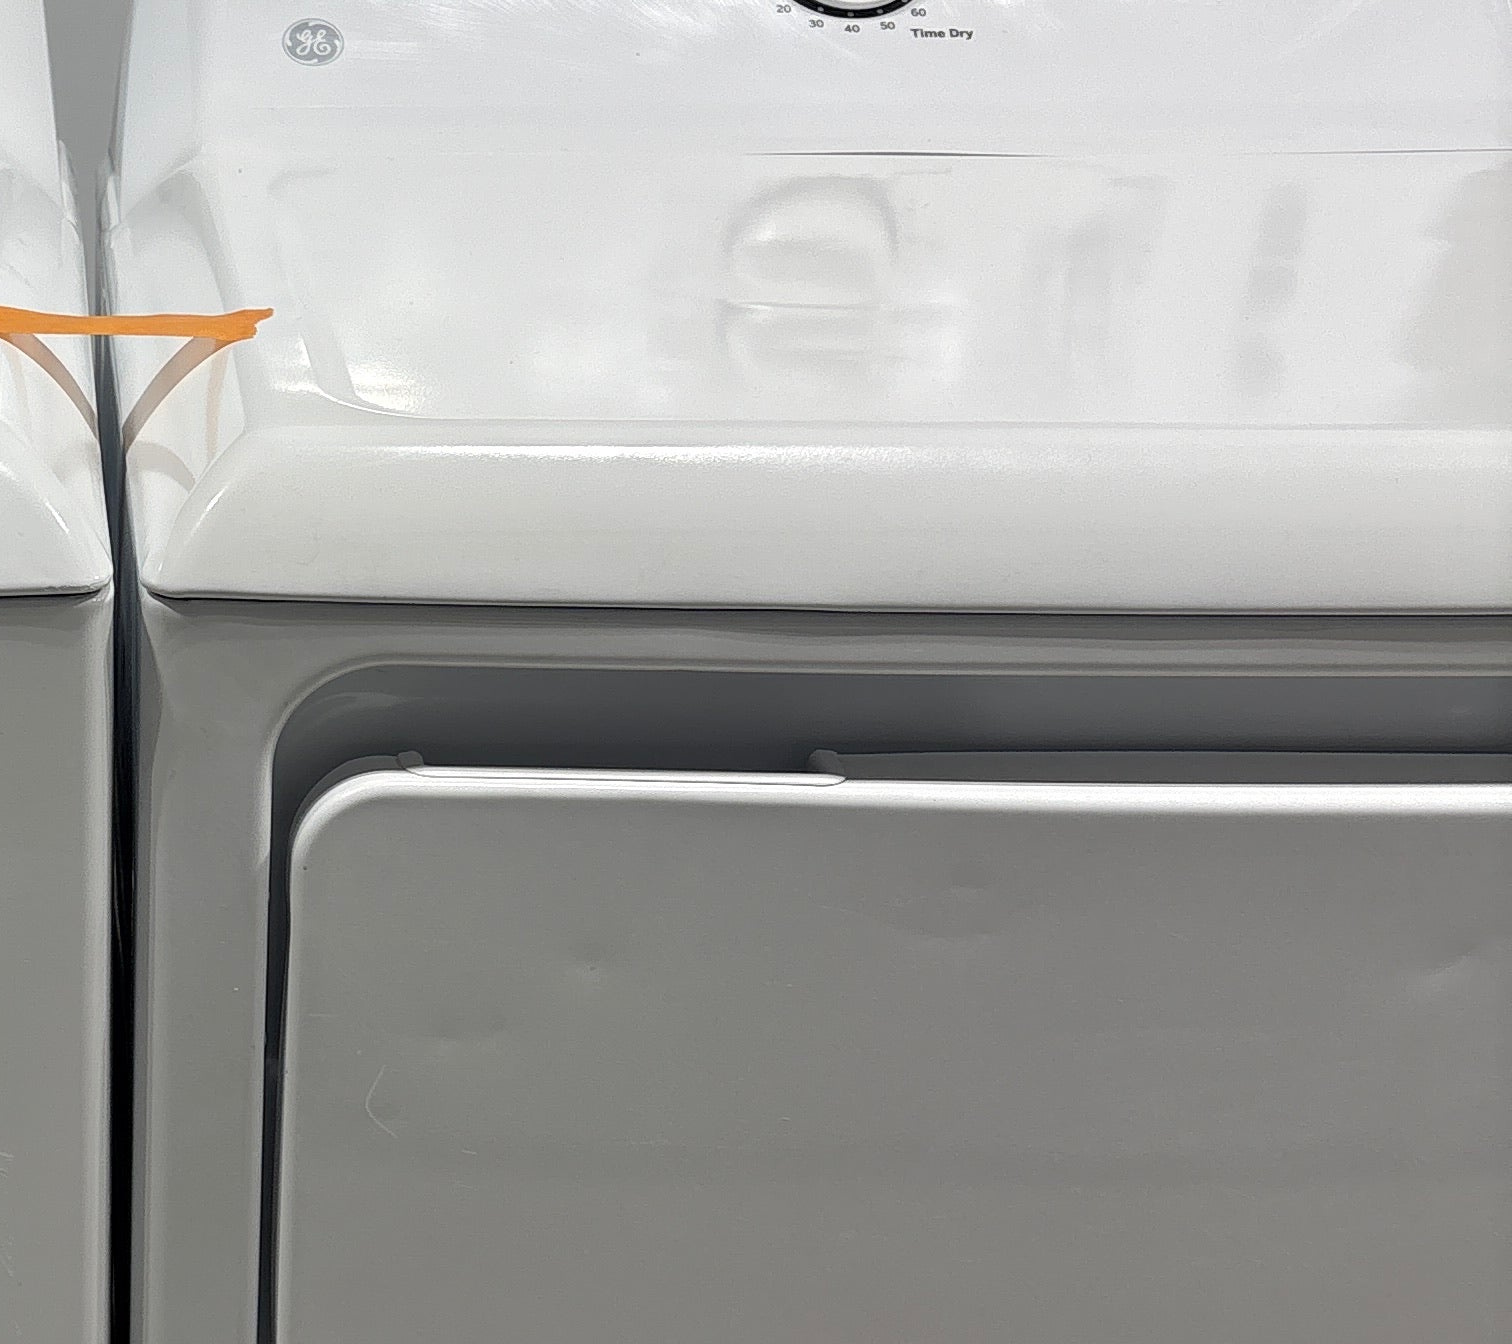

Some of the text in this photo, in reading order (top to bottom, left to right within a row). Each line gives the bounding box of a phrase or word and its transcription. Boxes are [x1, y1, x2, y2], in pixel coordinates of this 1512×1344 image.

[776, 4, 792, 14] 20
[910, 8, 927, 18] 60
[808, 19, 825, 28] 30
[880, 21, 896, 31] 50
[844, 24, 861, 34] 40
[910, 28, 975, 40] Time Dry
